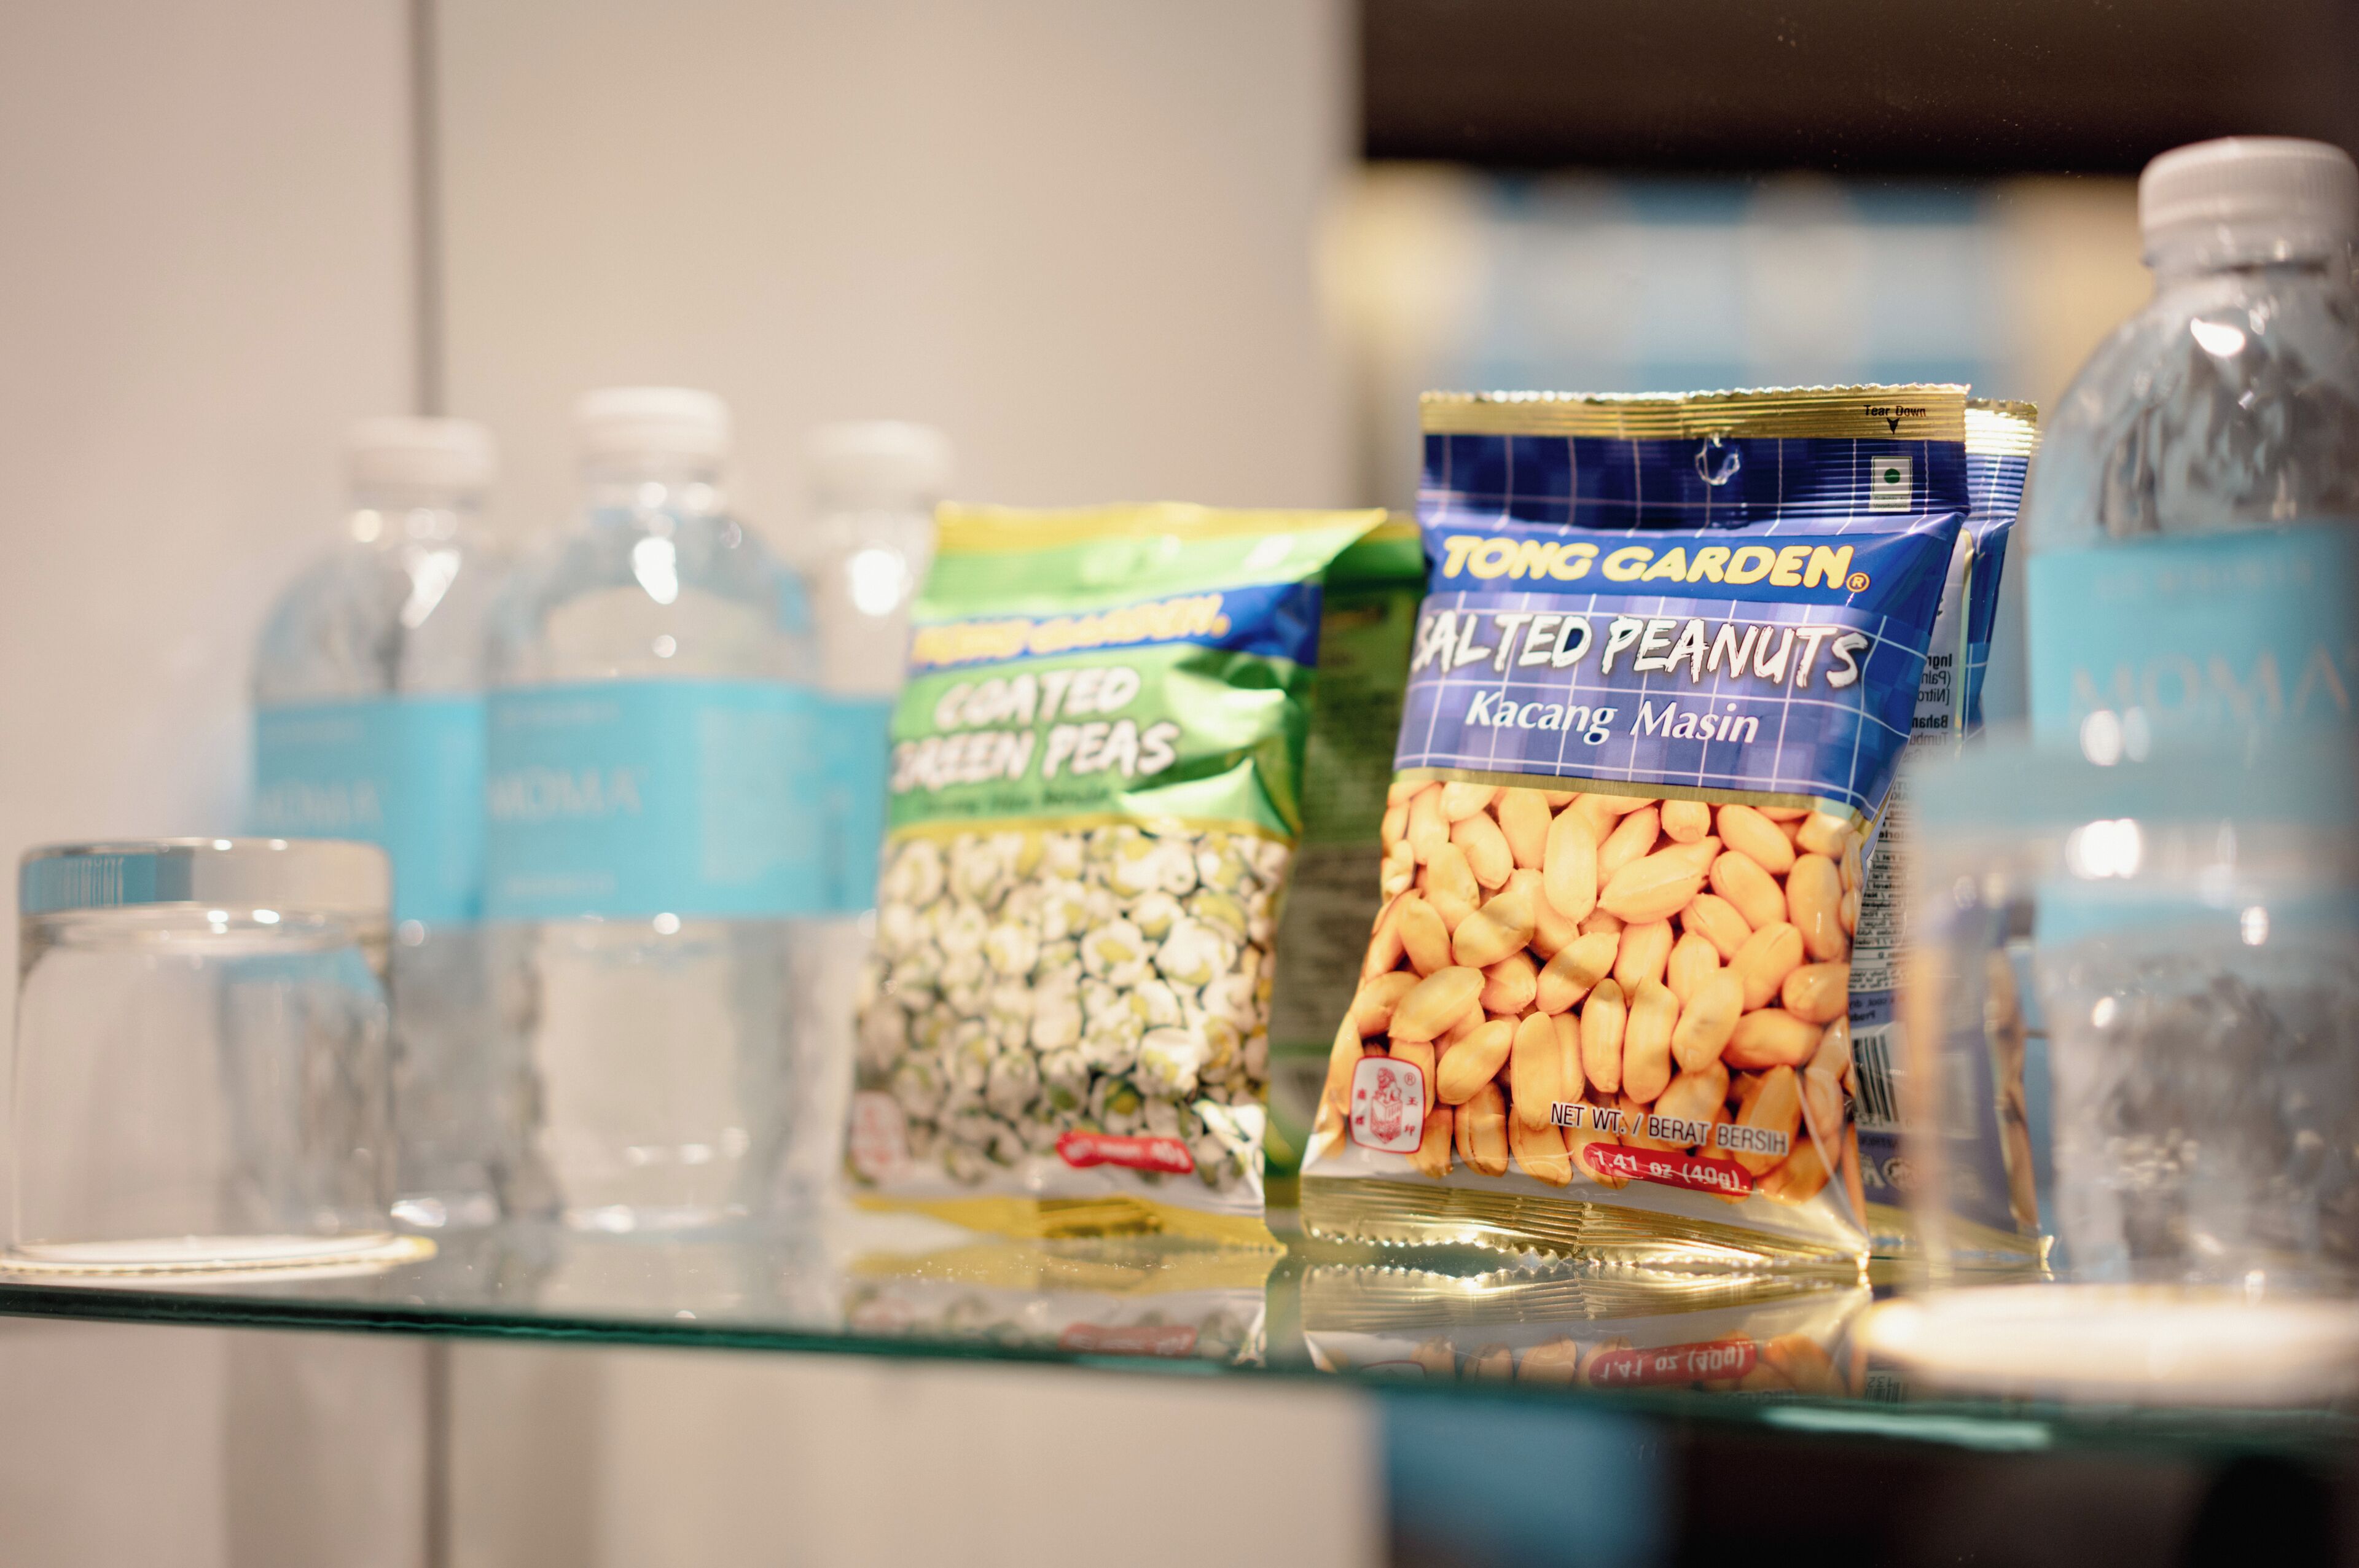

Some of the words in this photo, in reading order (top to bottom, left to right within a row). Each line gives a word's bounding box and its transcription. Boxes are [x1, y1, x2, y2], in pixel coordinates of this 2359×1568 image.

[1863, 405, 1890, 416] Tear
[1895, 405, 1927, 418] Down
[1443, 536, 1600, 581] TONG
[1601, 545, 1854, 590] GARDEN
[1411, 610, 1591, 674] SALTED
[1601, 614, 1869, 690] PEANUTS
[933, 666, 1141, 730] COATED
[1466, 688, 1618, 745] Kacang
[1630, 699, 1759, 744] Masin
[1042, 719, 1180, 779] PEAS
[1551, 1103, 1584, 1126] NET
[1593, 1109, 1626, 1134] WT.
[1632, 1114, 1644, 1135] /
[1649, 1116, 1710, 1143] BERAT
[1718, 1126, 1787, 1153] BERSIH
[1595, 1150, 1638, 1171] 1.41
[1649, 1161, 1673, 1179] oz
[1682, 1164, 1740, 1190] (40g)
